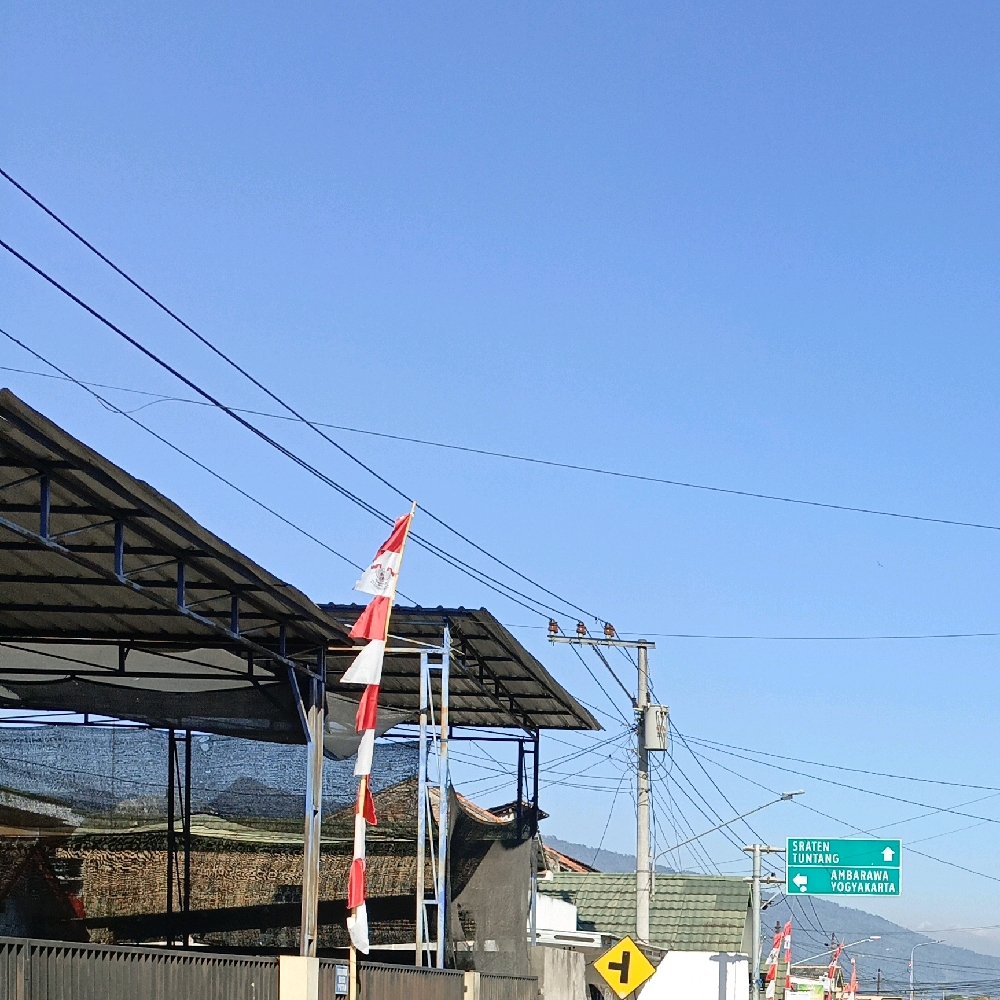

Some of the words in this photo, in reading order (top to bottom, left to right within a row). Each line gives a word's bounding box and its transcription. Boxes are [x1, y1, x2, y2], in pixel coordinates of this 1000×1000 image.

[792, 841, 830, 852] SRATEN
[792, 853, 840, 864] TUNTANG
[830, 870, 889, 881] AMBARAWA
[830, 881, 896, 893] YOGYAKARTA
